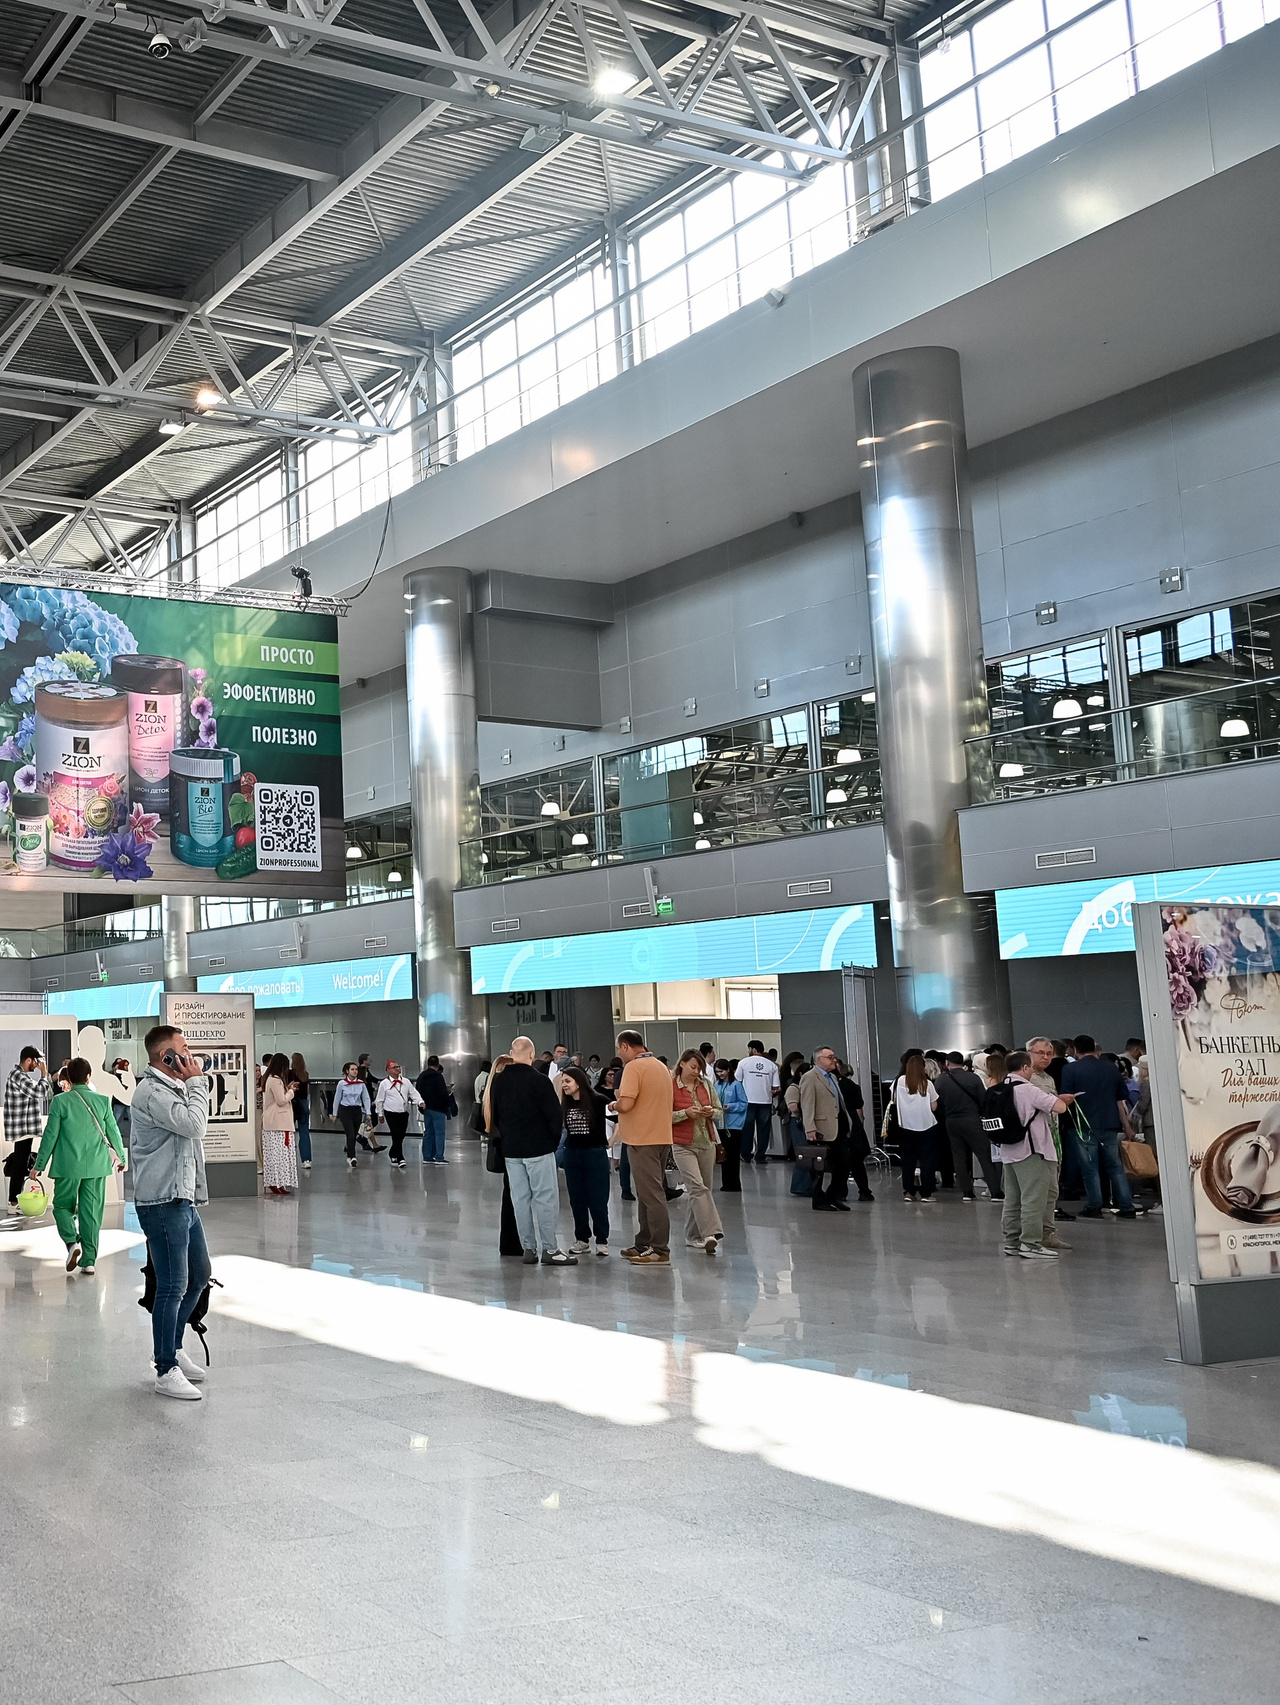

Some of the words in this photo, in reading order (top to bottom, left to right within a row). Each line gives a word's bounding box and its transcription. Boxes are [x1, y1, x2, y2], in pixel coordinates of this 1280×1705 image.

[260, 645, 315, 666] ПРОСТО
[222, 682, 316, 706] ЭФФЕКТИВНО
[135, 713, 167, 724] ZION
[134, 724, 168, 736] Detox
[252, 726, 318, 747] ПОЛЕЗНО
[61, 753, 102, 768] ZION
[260, 858, 319, 868] ZIONPROFESSIONAL
[332, 969, 384, 990] Welcome!
[174, 1002, 205, 1011] ДИЗАЙН
[517, 1008, 537, 1023] Hall
[1235, 1058, 1267, 1076] ЗАЛ
[1221, 1068, 1245, 1088] Для
[1248, 1070, 1280, 1089] ваших
